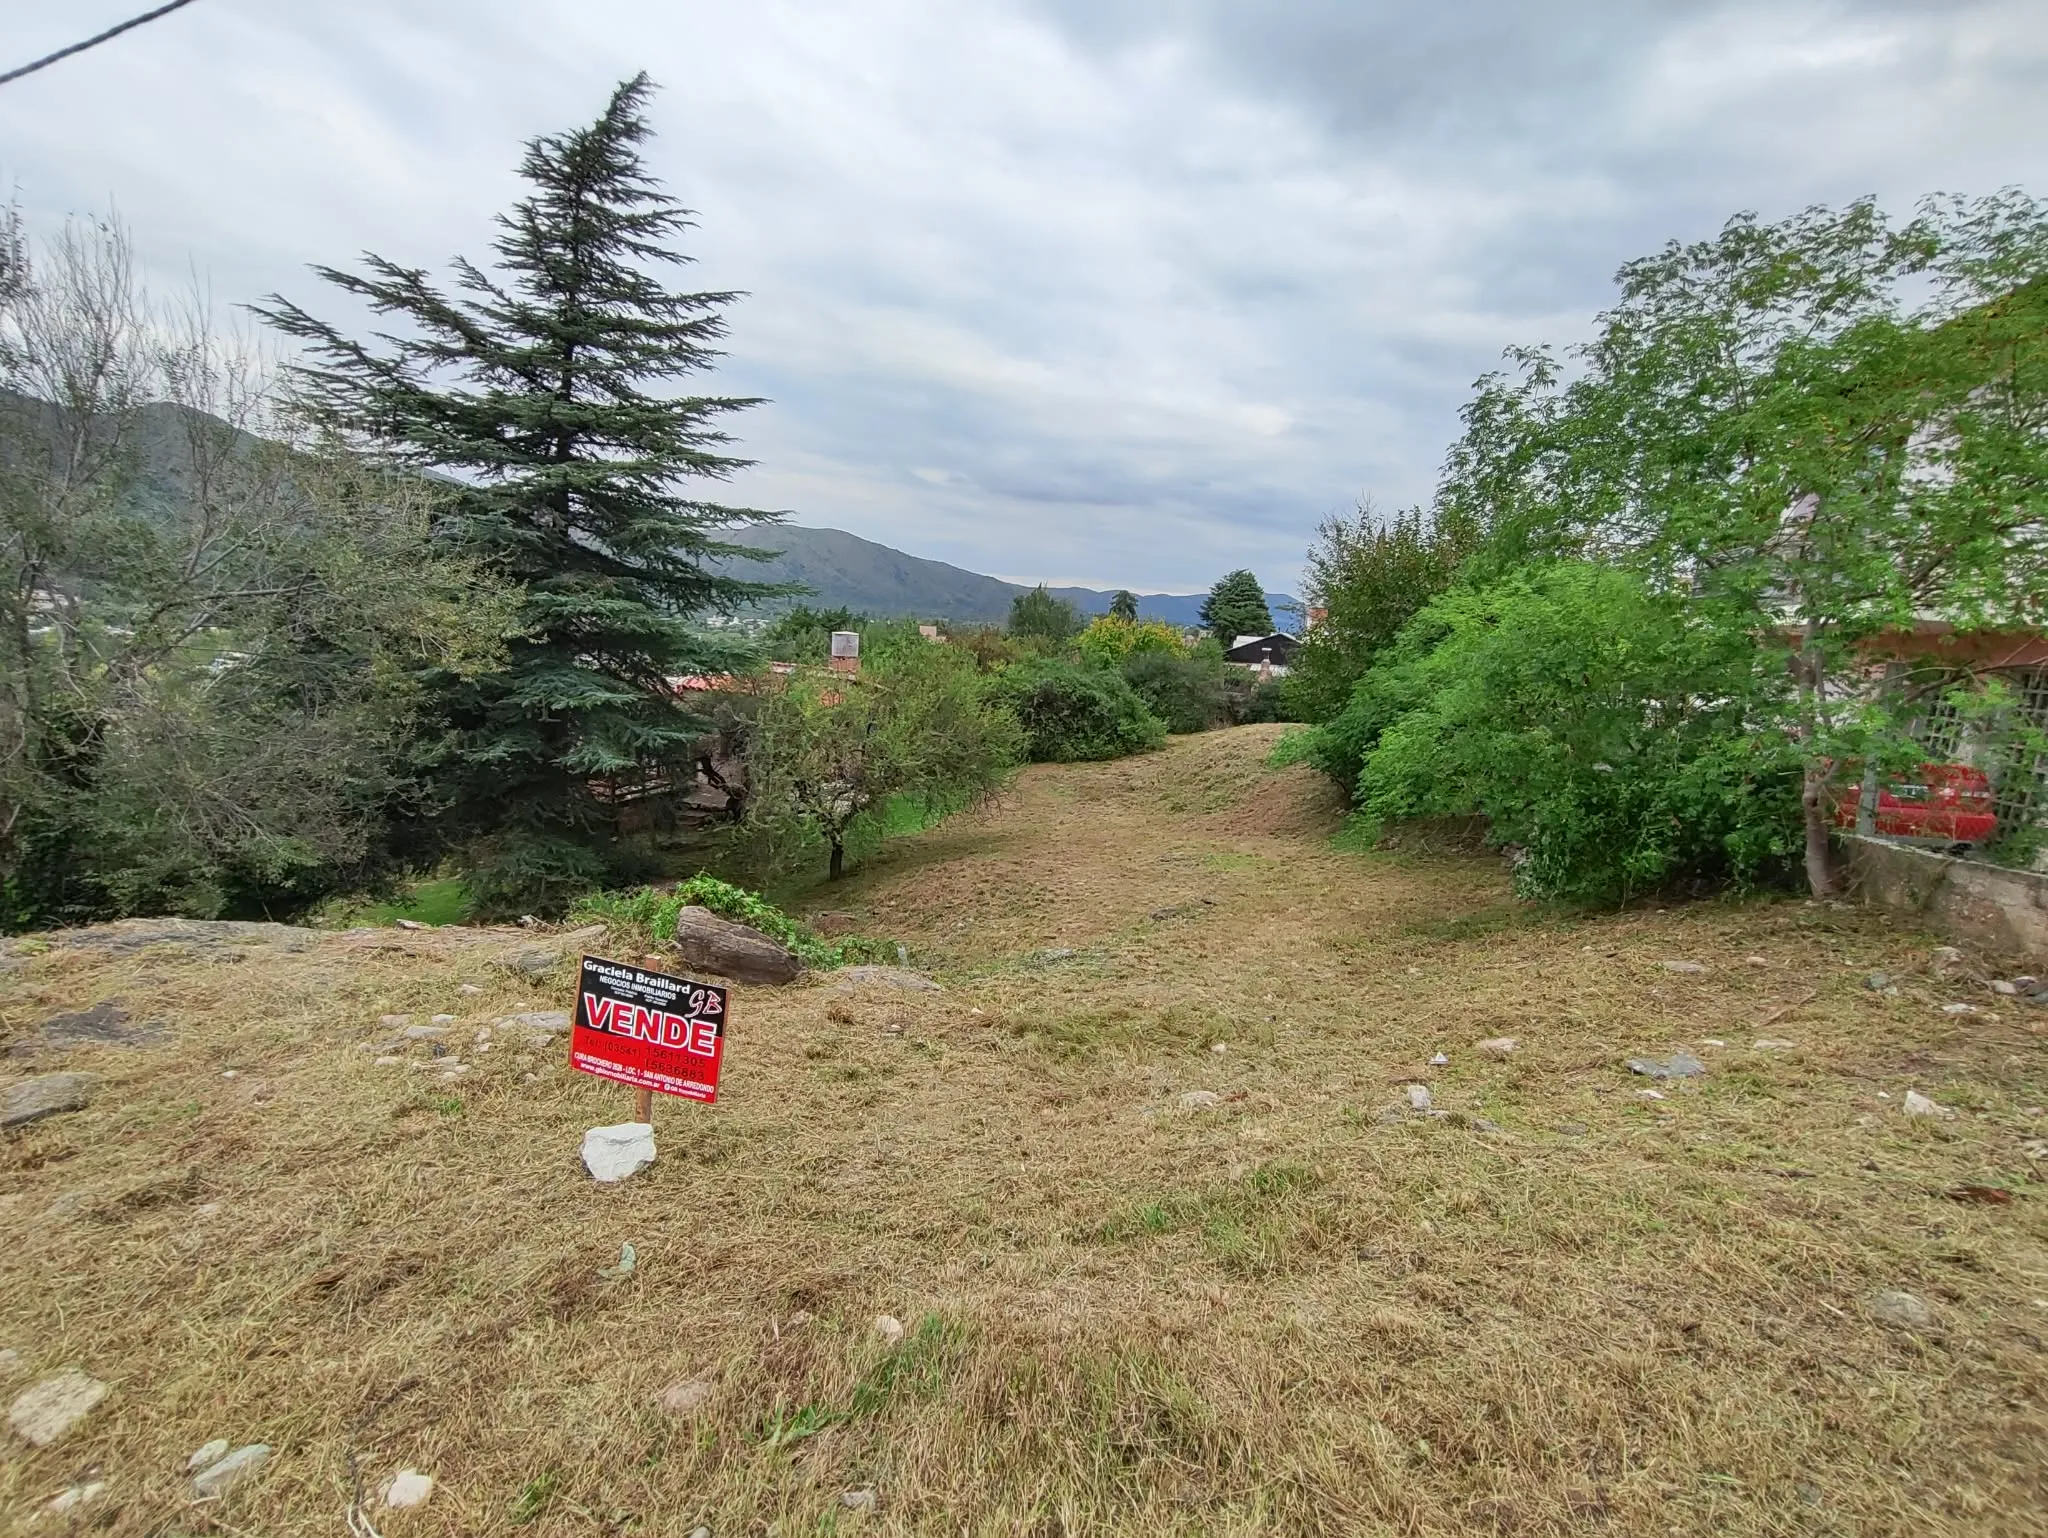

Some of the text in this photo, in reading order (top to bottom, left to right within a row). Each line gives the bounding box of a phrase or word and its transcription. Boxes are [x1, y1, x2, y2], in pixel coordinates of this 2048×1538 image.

[583, 960, 633, 980] Graciela
[636, 972, 691, 994] Braillard
[599, 975, 631, 989] NEGOCIOS
[631, 983, 677, 1000] INMOBILIARIOS
[583, 992, 717, 1057] VENDE
[604, 1041, 641, 1057] (03541)
[646, 1047, 706, 1067] 15611305
[645, 1058, 705, 1080] 15636883
[653, 1073, 676, 1084] ANTONIO
[675, 1077, 683, 1087] DE
